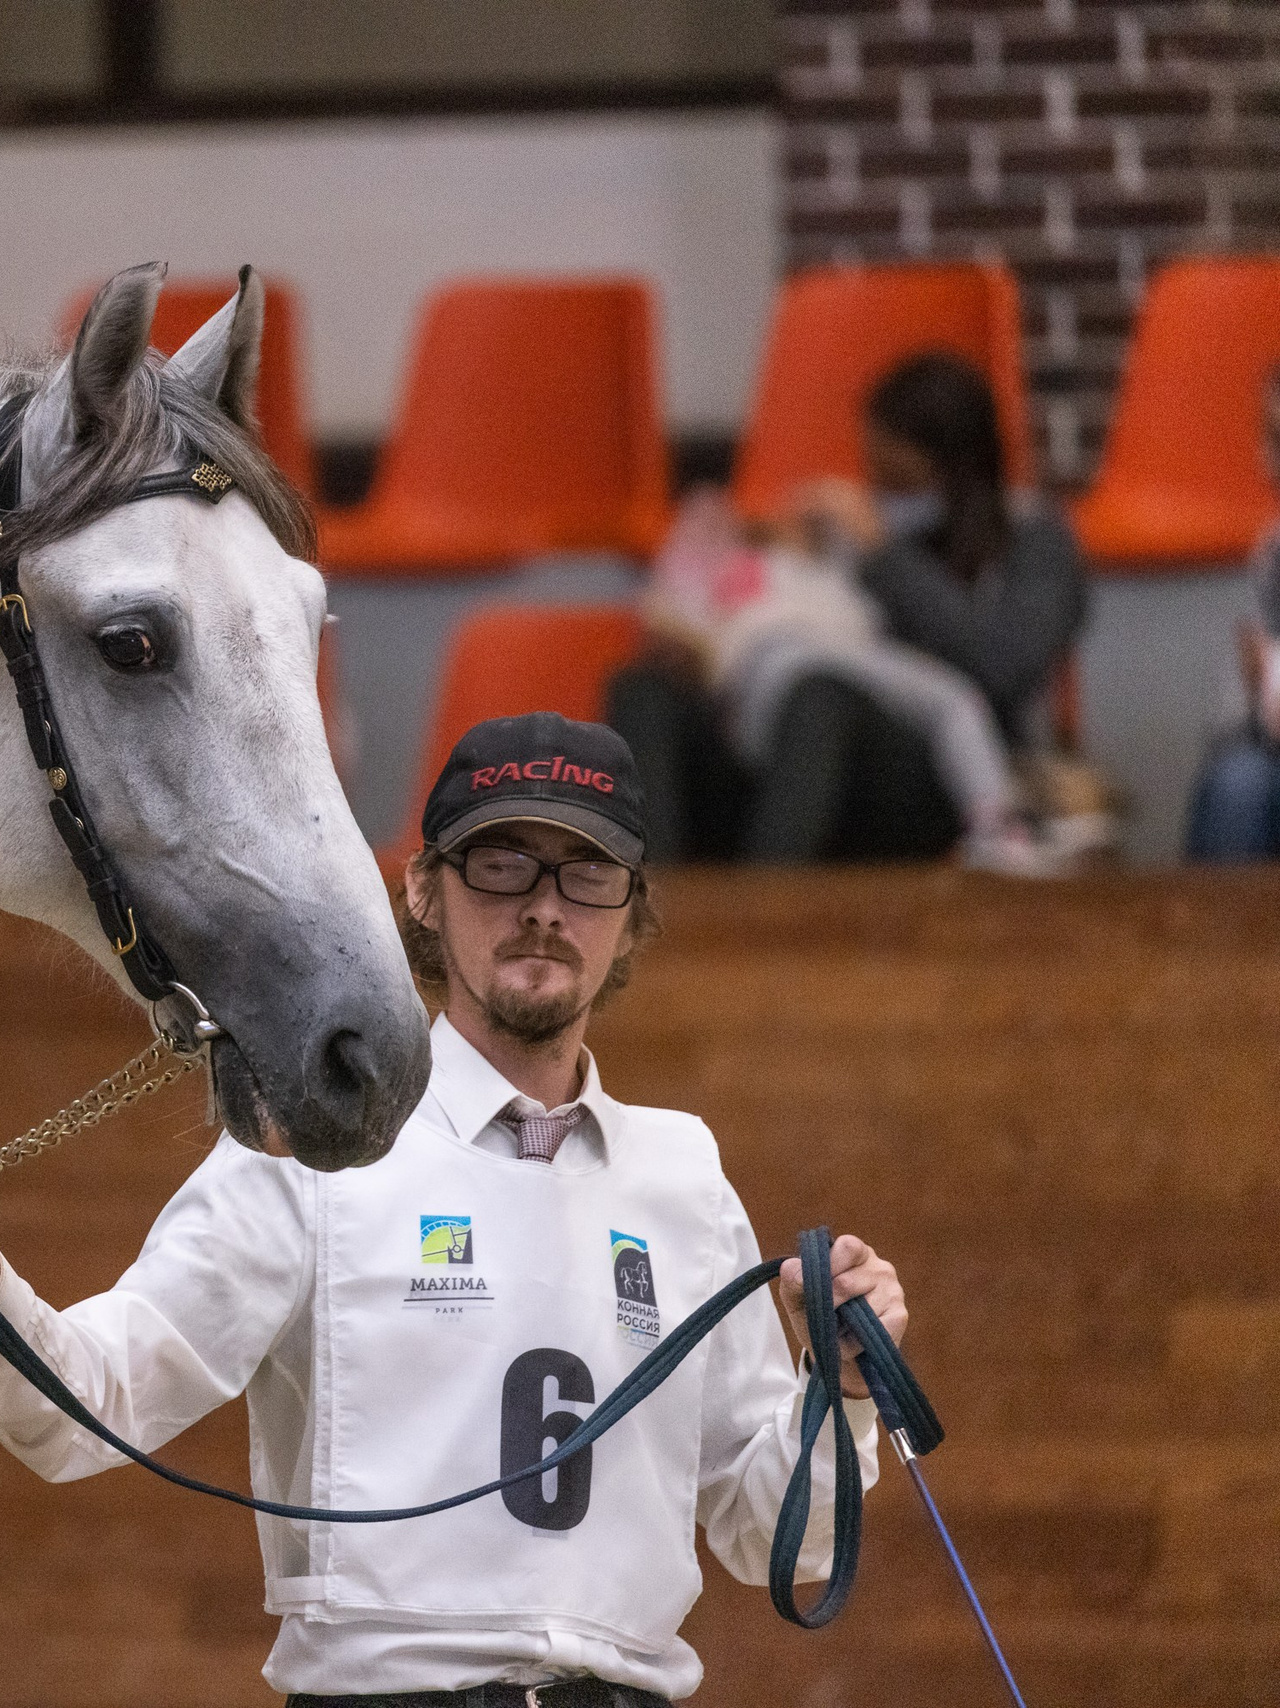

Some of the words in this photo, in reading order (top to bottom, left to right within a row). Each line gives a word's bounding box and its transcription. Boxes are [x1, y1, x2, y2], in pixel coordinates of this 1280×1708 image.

[410, 1277, 487, 1292] MAXIMA
[617, 1299, 660, 1320] КОННАЯ
[616, 1314, 660, 1334] РОССИЯ
[500, 1348, 595, 1531] 6
